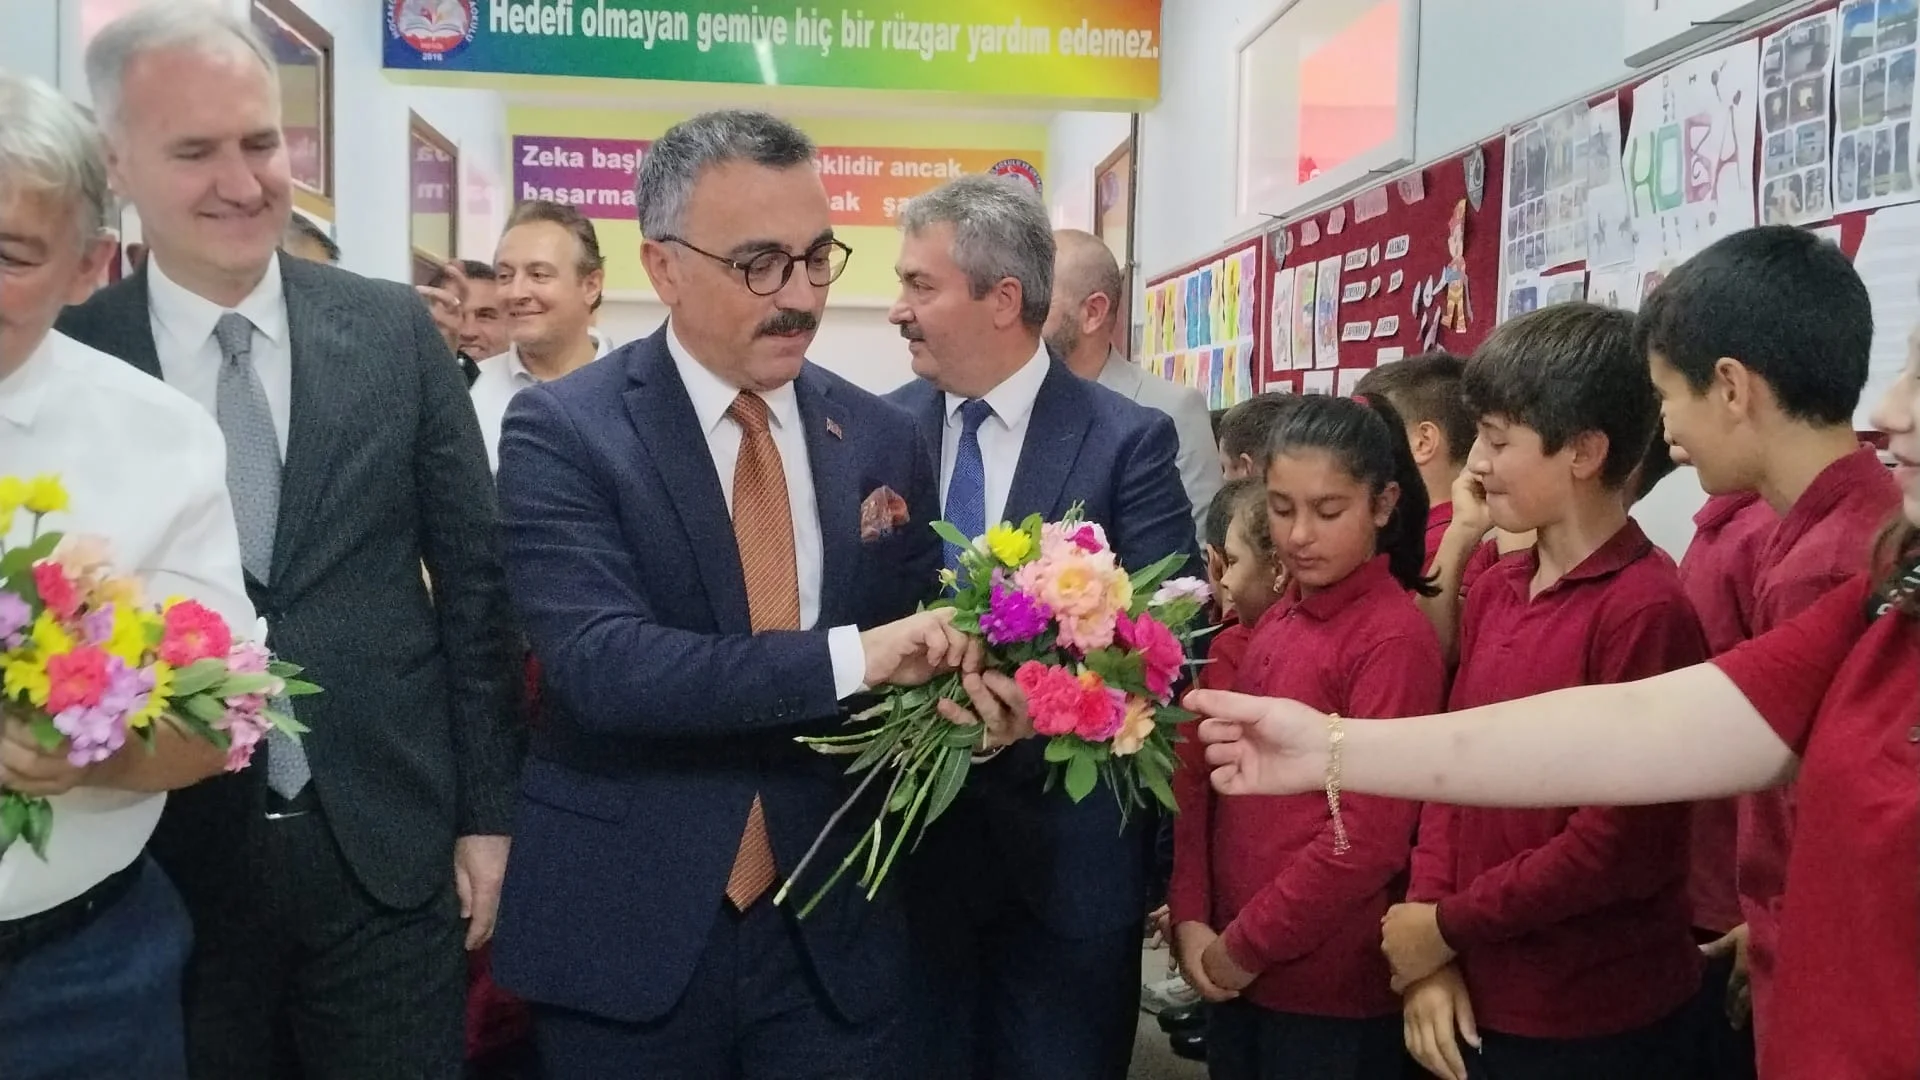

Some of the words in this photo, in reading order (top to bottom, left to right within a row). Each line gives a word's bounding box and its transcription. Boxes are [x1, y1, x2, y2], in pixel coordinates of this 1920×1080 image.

[489, 0, 573, 36] Hedefi
[581, 0, 689, 49] olmayan
[696, 6, 788, 52] gemiye
[795, 8, 832, 57] hiç
[841, 10, 874, 49] bir
[882, 12, 960, 61] rüzgar
[967, 18, 1050, 62] yardım
[1058, 19, 1160, 59] edemez.
[522, 145, 584, 168] Zeka
[592, 147, 643, 174] başl
[812, 154, 883, 177] eklidir
[523, 181, 638, 206] başarma
[829, 191, 861, 213] ak
